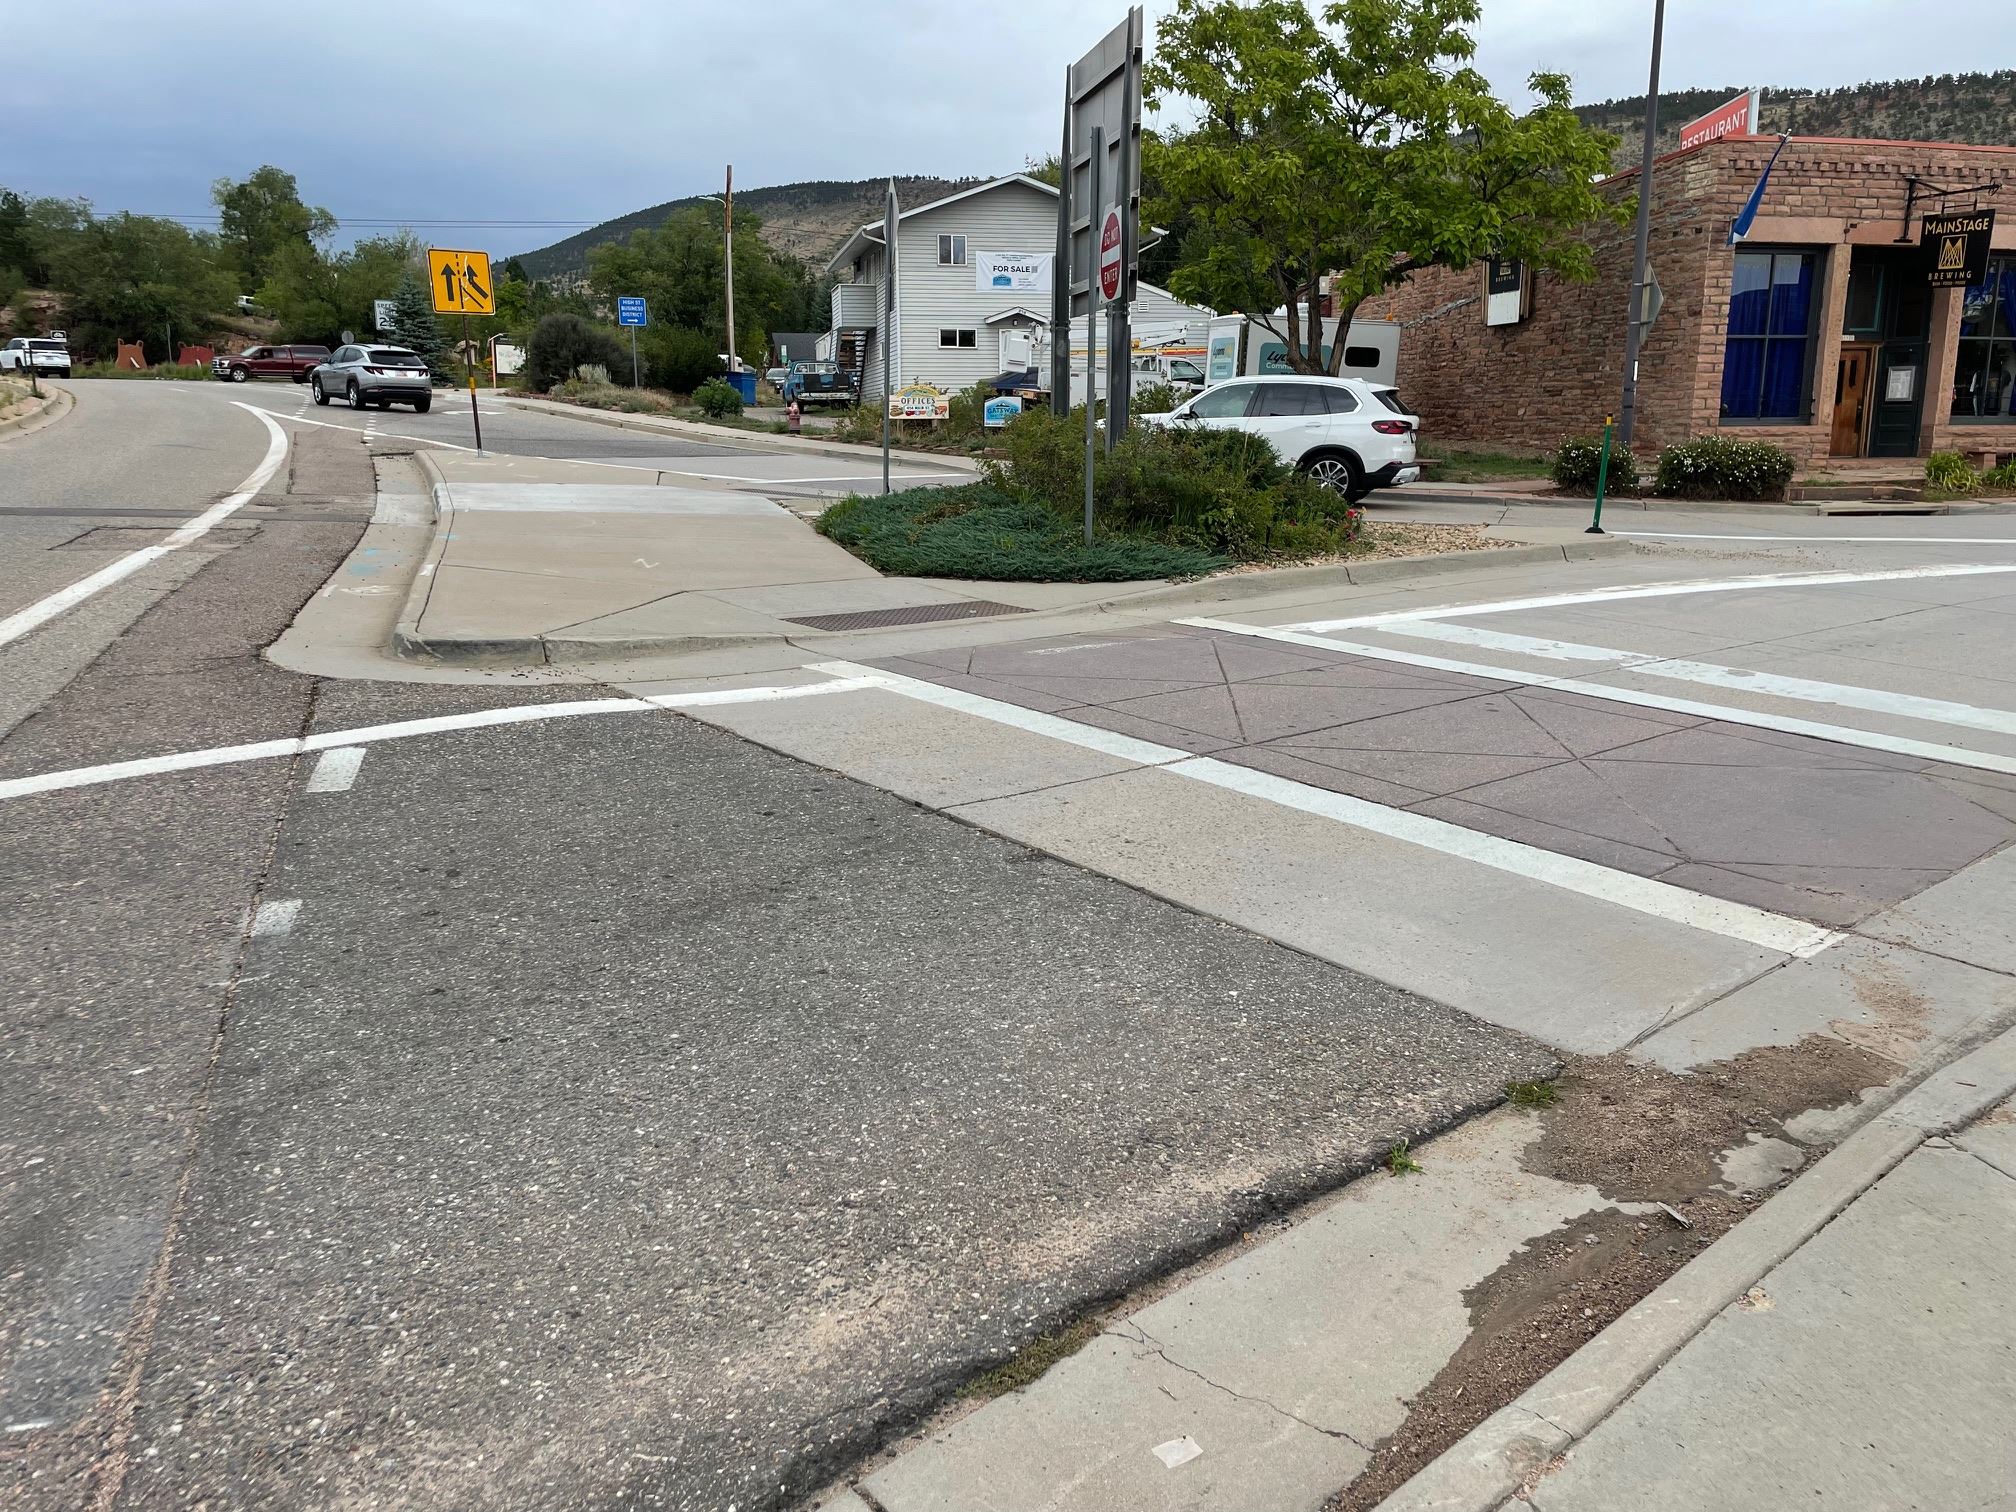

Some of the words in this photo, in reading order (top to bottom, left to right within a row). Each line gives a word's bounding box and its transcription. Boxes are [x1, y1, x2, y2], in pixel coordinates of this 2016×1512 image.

[1681, 107, 1748, 150] RESTAURANT
[993, 265, 1009, 273] FOR
[1010, 265, 1031, 273] SALE
[1104, 267, 1118, 285] ENTER
[1928, 270, 1972, 281] BREWING
[901, 397, 936, 405] OFFICES
